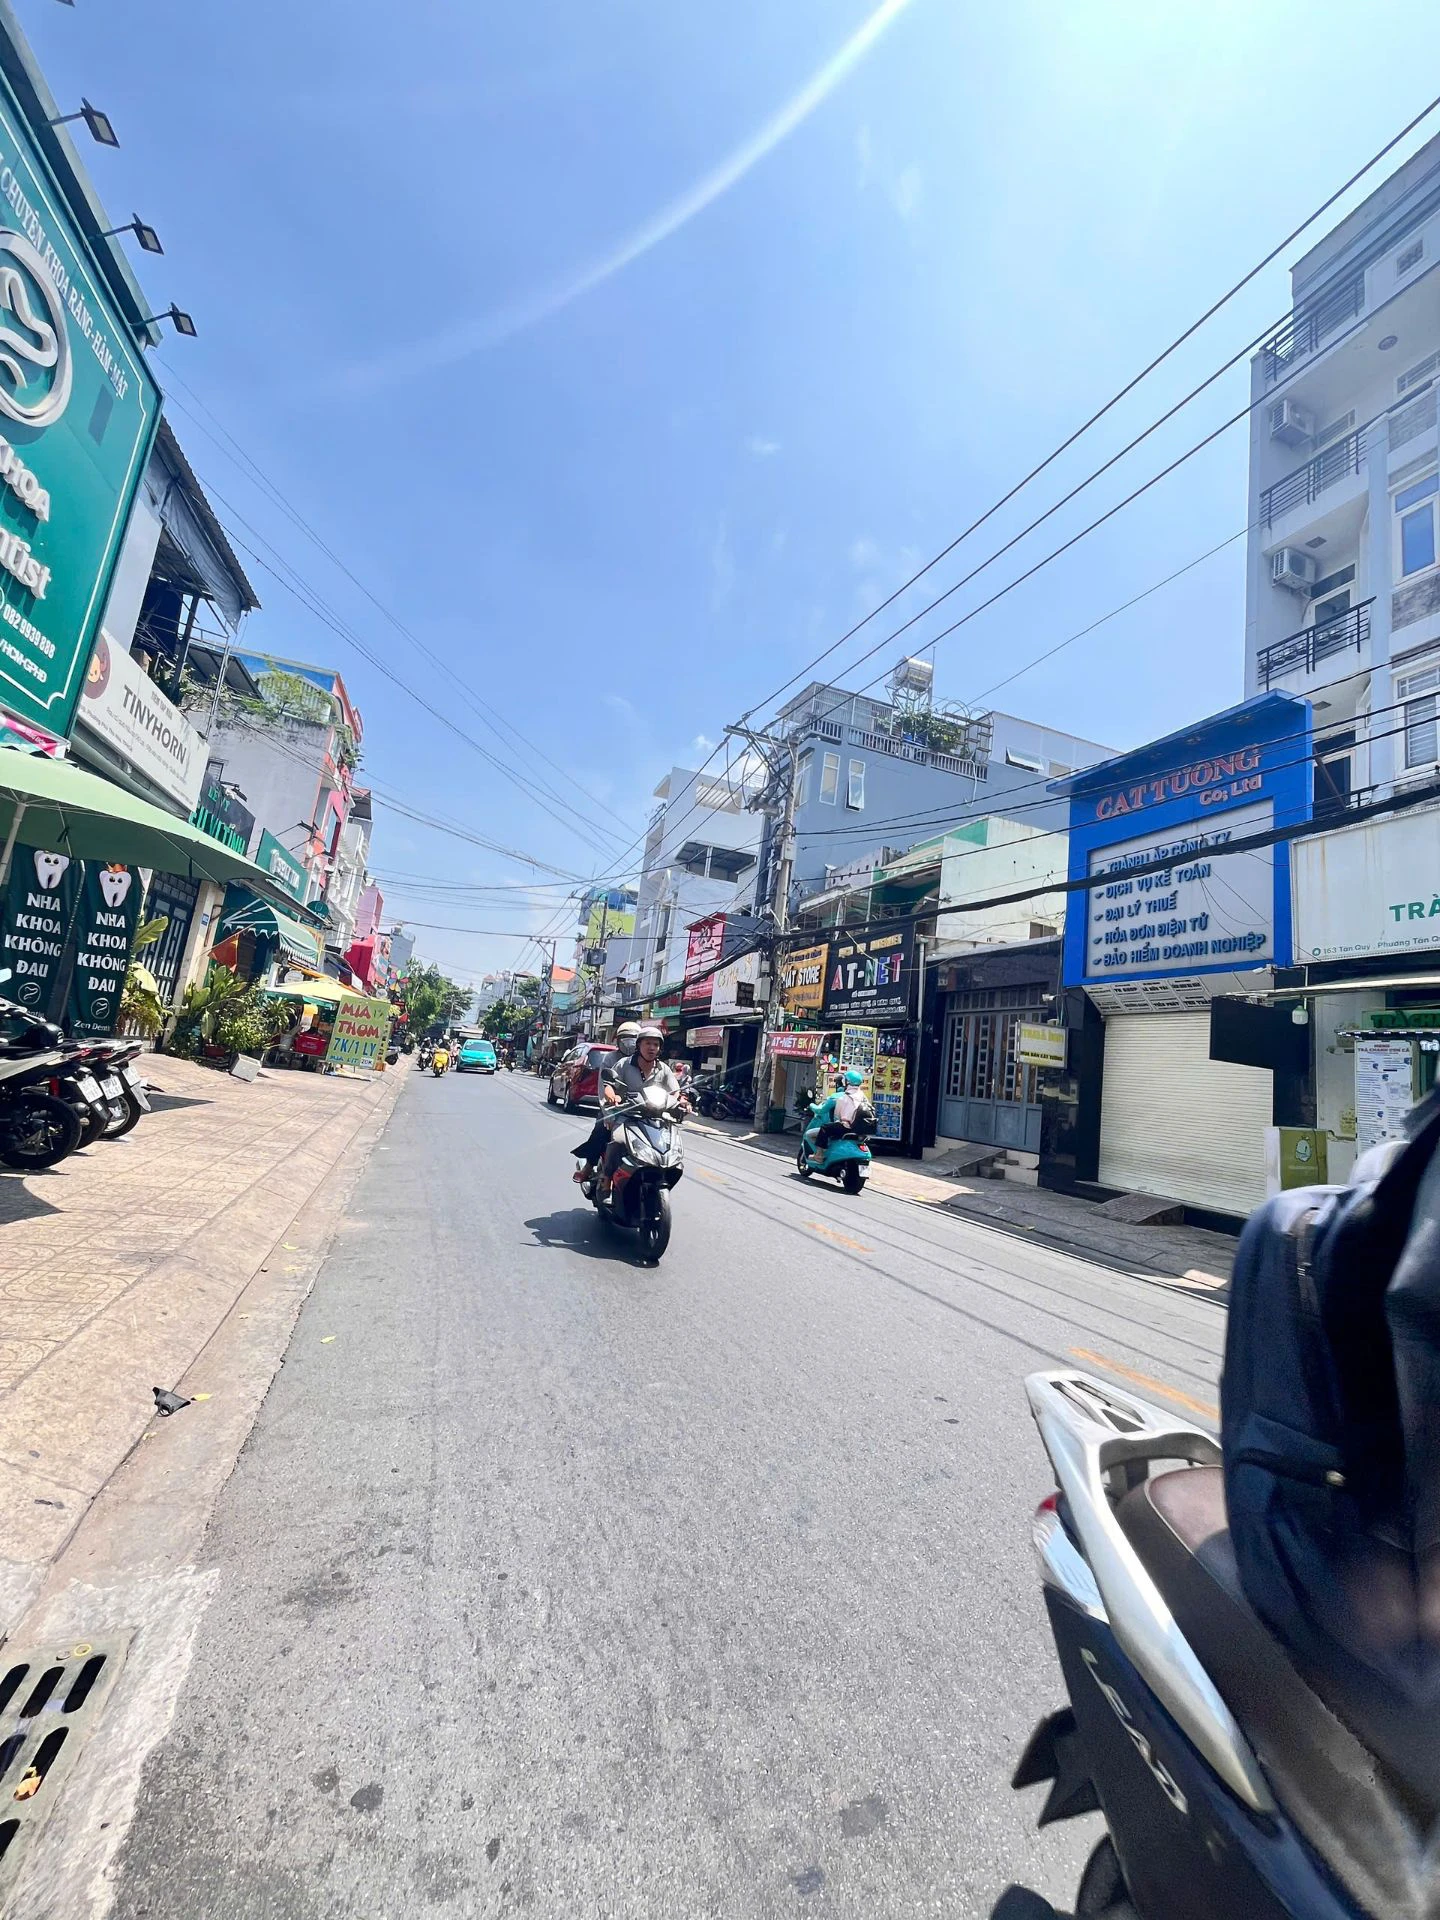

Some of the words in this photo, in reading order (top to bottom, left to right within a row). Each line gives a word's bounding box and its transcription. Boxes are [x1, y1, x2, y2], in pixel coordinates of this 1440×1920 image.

[1, 166, 46, 257] CHUYÊN
[44, 240, 71, 294] KHOA
[122, 683, 187, 765] TINYHORN
[1230, 774, 1262, 796] Ltd
[1105, 882, 1133, 899] DỊCH
[1137, 878, 1153, 893] VỤ
[1175, 862, 1212, 884] TOÁN
[26, 892, 61, 912] NHA
[1105, 905, 1124, 921] ĐẠI
[1127, 899, 1142, 916] LÝ
[1145, 890, 1179, 914] THUẾ
[15, 913, 61, 935] KHOA
[95, 911, 126, 929] NHA
[1104, 925, 1127, 944] HÓA
[1129, 924, 1156, 940] ĐƠN
[1157, 918, 1186, 938] ĐIỆN
[1189, 911, 1210, 932] TỬ
[4, 932, 62, 957] KHÔNG
[87, 932, 127, 950] KHOA
[1103, 947, 1127, 967] BẢO
[1130, 942, 1160, 963] HIỂM
[1162, 940, 1209, 958] DOANH
[1211, 932, 1267, 955] NGHIỆP
[16, 959, 49, 978] ĐAU
[76, 951, 126, 972] KHÔNG
[830, 953, 905, 991] AT-NET
[88, 976, 116, 993] ĐAU
[798, 964, 821, 986] STORE
[74, 1020, 91, 1029] Zen
